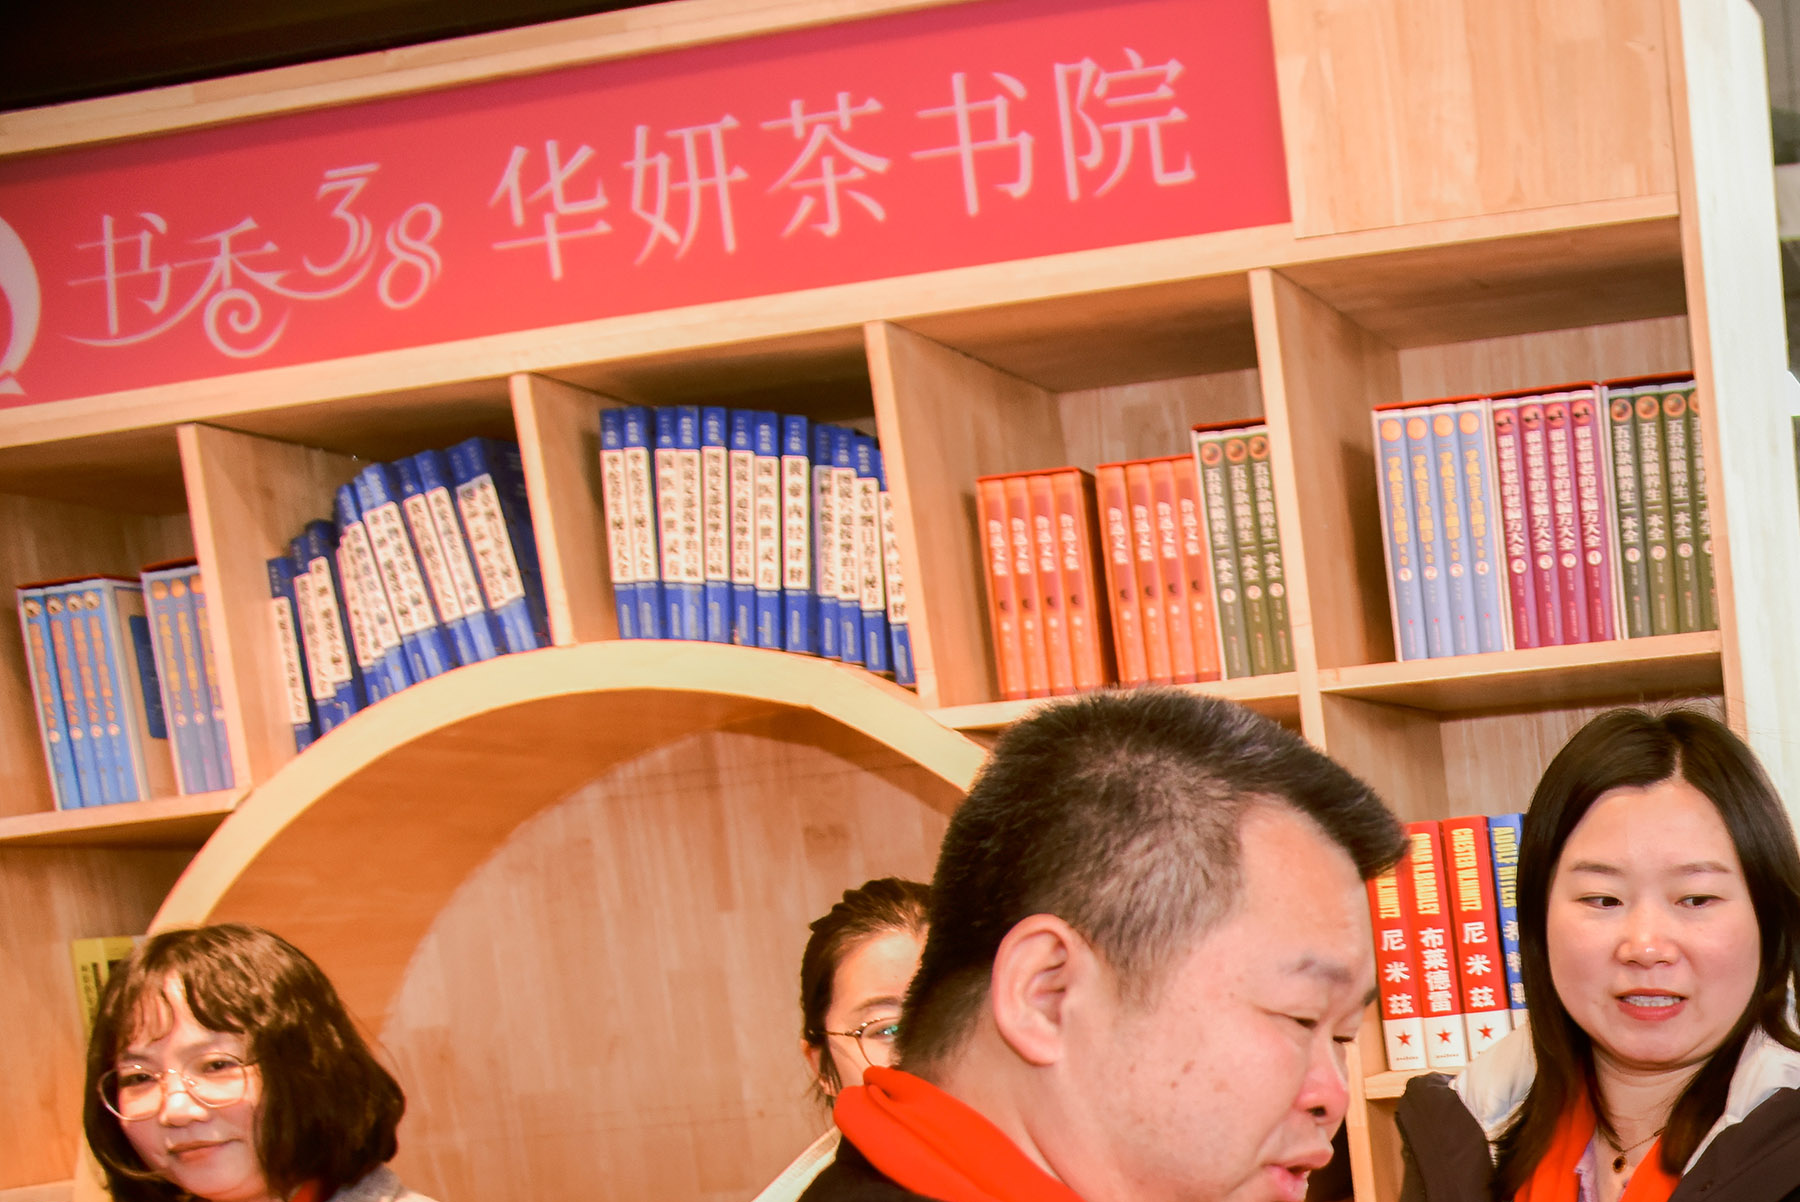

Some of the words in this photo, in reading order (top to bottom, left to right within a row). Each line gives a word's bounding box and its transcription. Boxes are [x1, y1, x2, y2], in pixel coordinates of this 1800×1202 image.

[489, 46, 1196, 282] 华妍茶书院
[1452, 828, 1477, 868] CHESTER
[1493, 827, 1518, 863] ADOLF
[1381, 929, 1414, 1015] 尼米兹
[1418, 927, 1452, 1013] 布莱德雷
[1462, 921, 1496, 1008] 尼米兹
